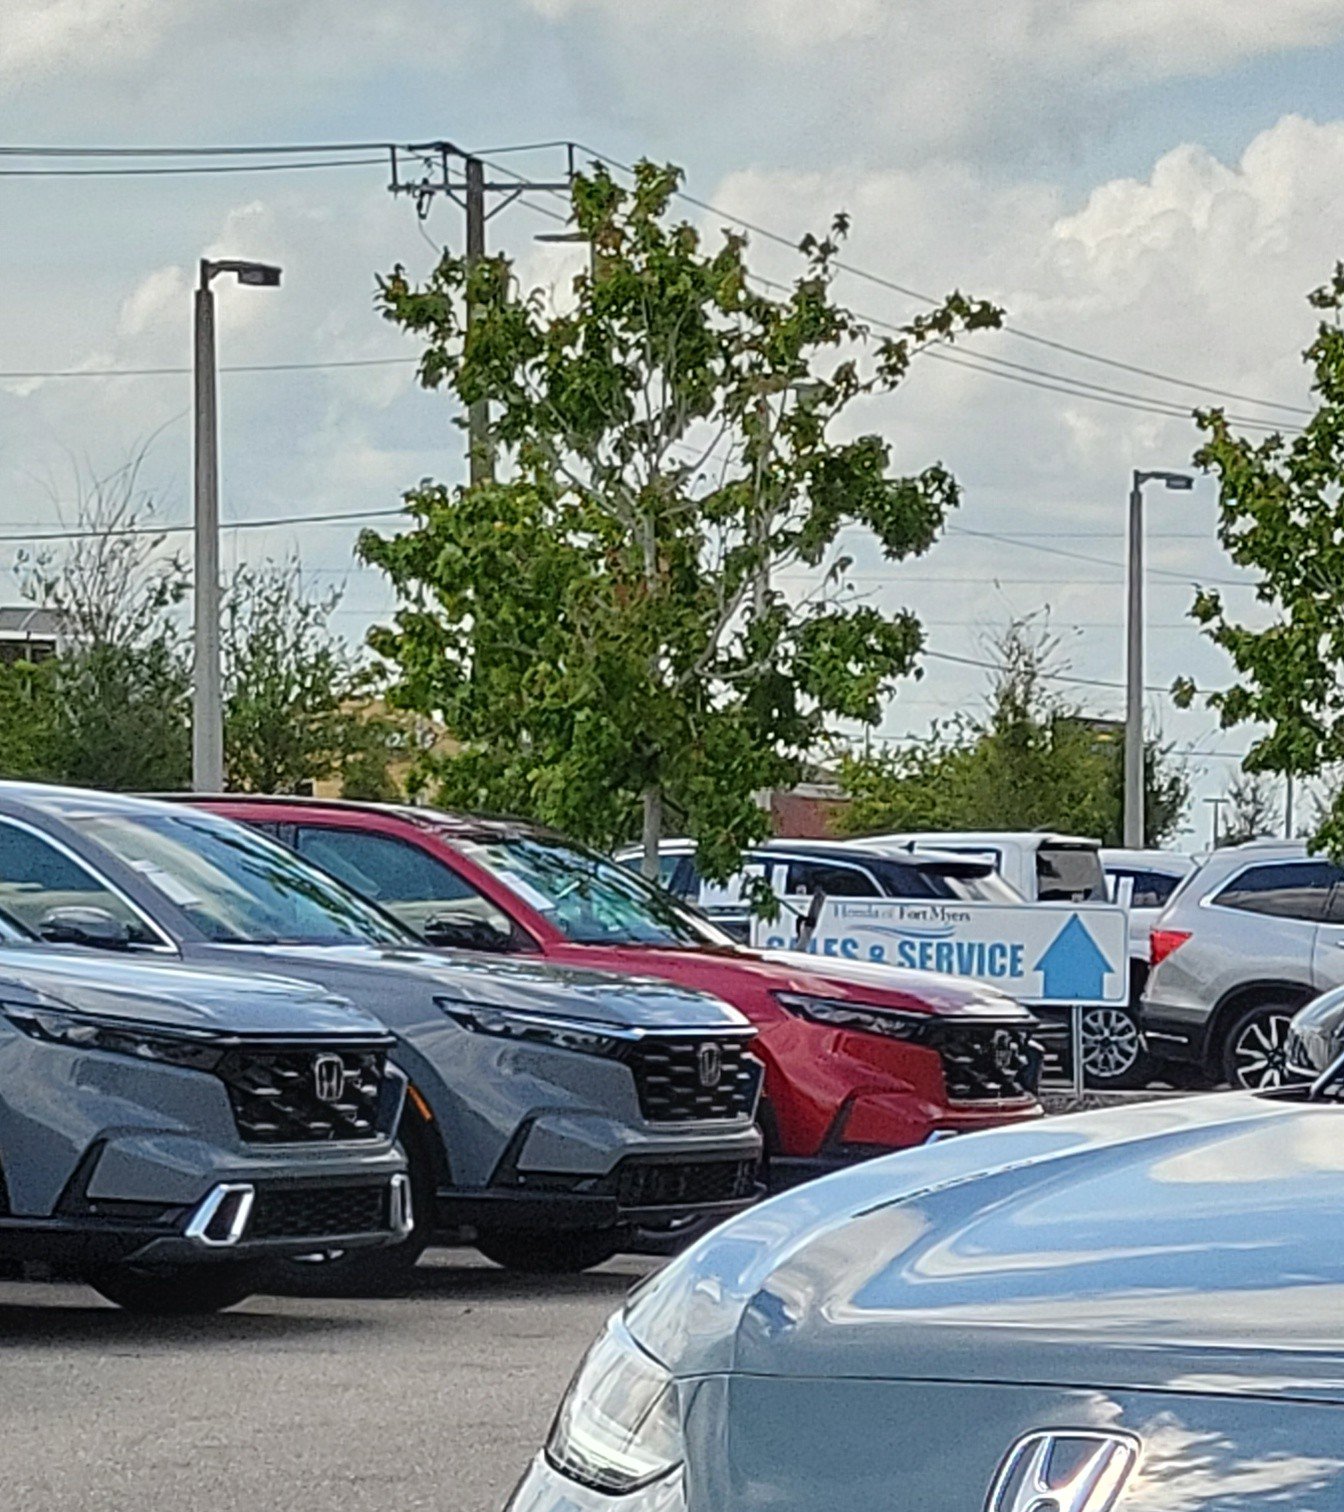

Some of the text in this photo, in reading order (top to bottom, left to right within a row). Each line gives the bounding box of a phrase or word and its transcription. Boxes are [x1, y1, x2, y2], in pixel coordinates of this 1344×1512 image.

[833, 903, 971, 925] Honda of Fort Myers
[897, 939, 1024, 978] SERVICE
